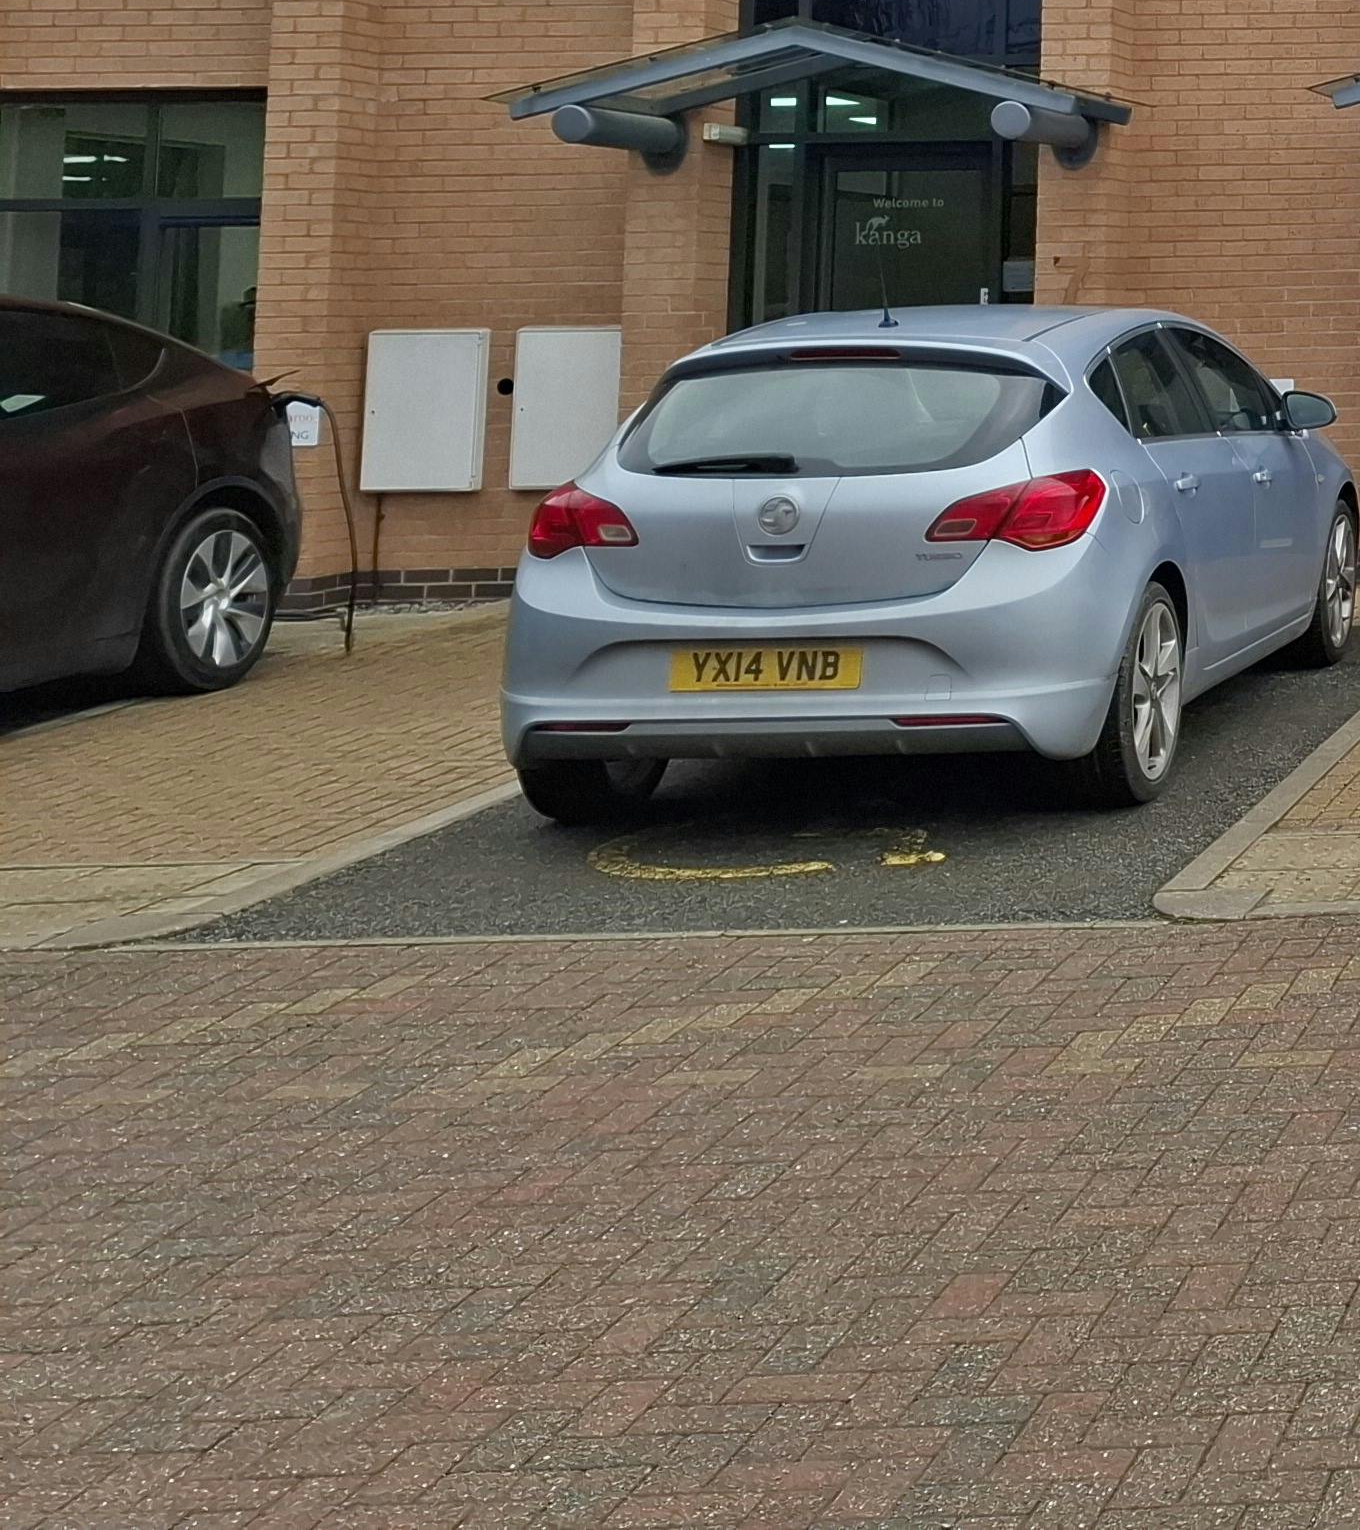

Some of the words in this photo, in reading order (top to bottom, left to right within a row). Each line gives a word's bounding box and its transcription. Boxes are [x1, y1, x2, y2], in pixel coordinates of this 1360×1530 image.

[873, 197, 929, 209] Welcome
[932, 197, 945, 208] to
[855, 221, 922, 250] kanga
[1053, 256, 1089, 305] 7
[692, 651, 764, 682] YX14
[777, 650, 840, 681] VNB
